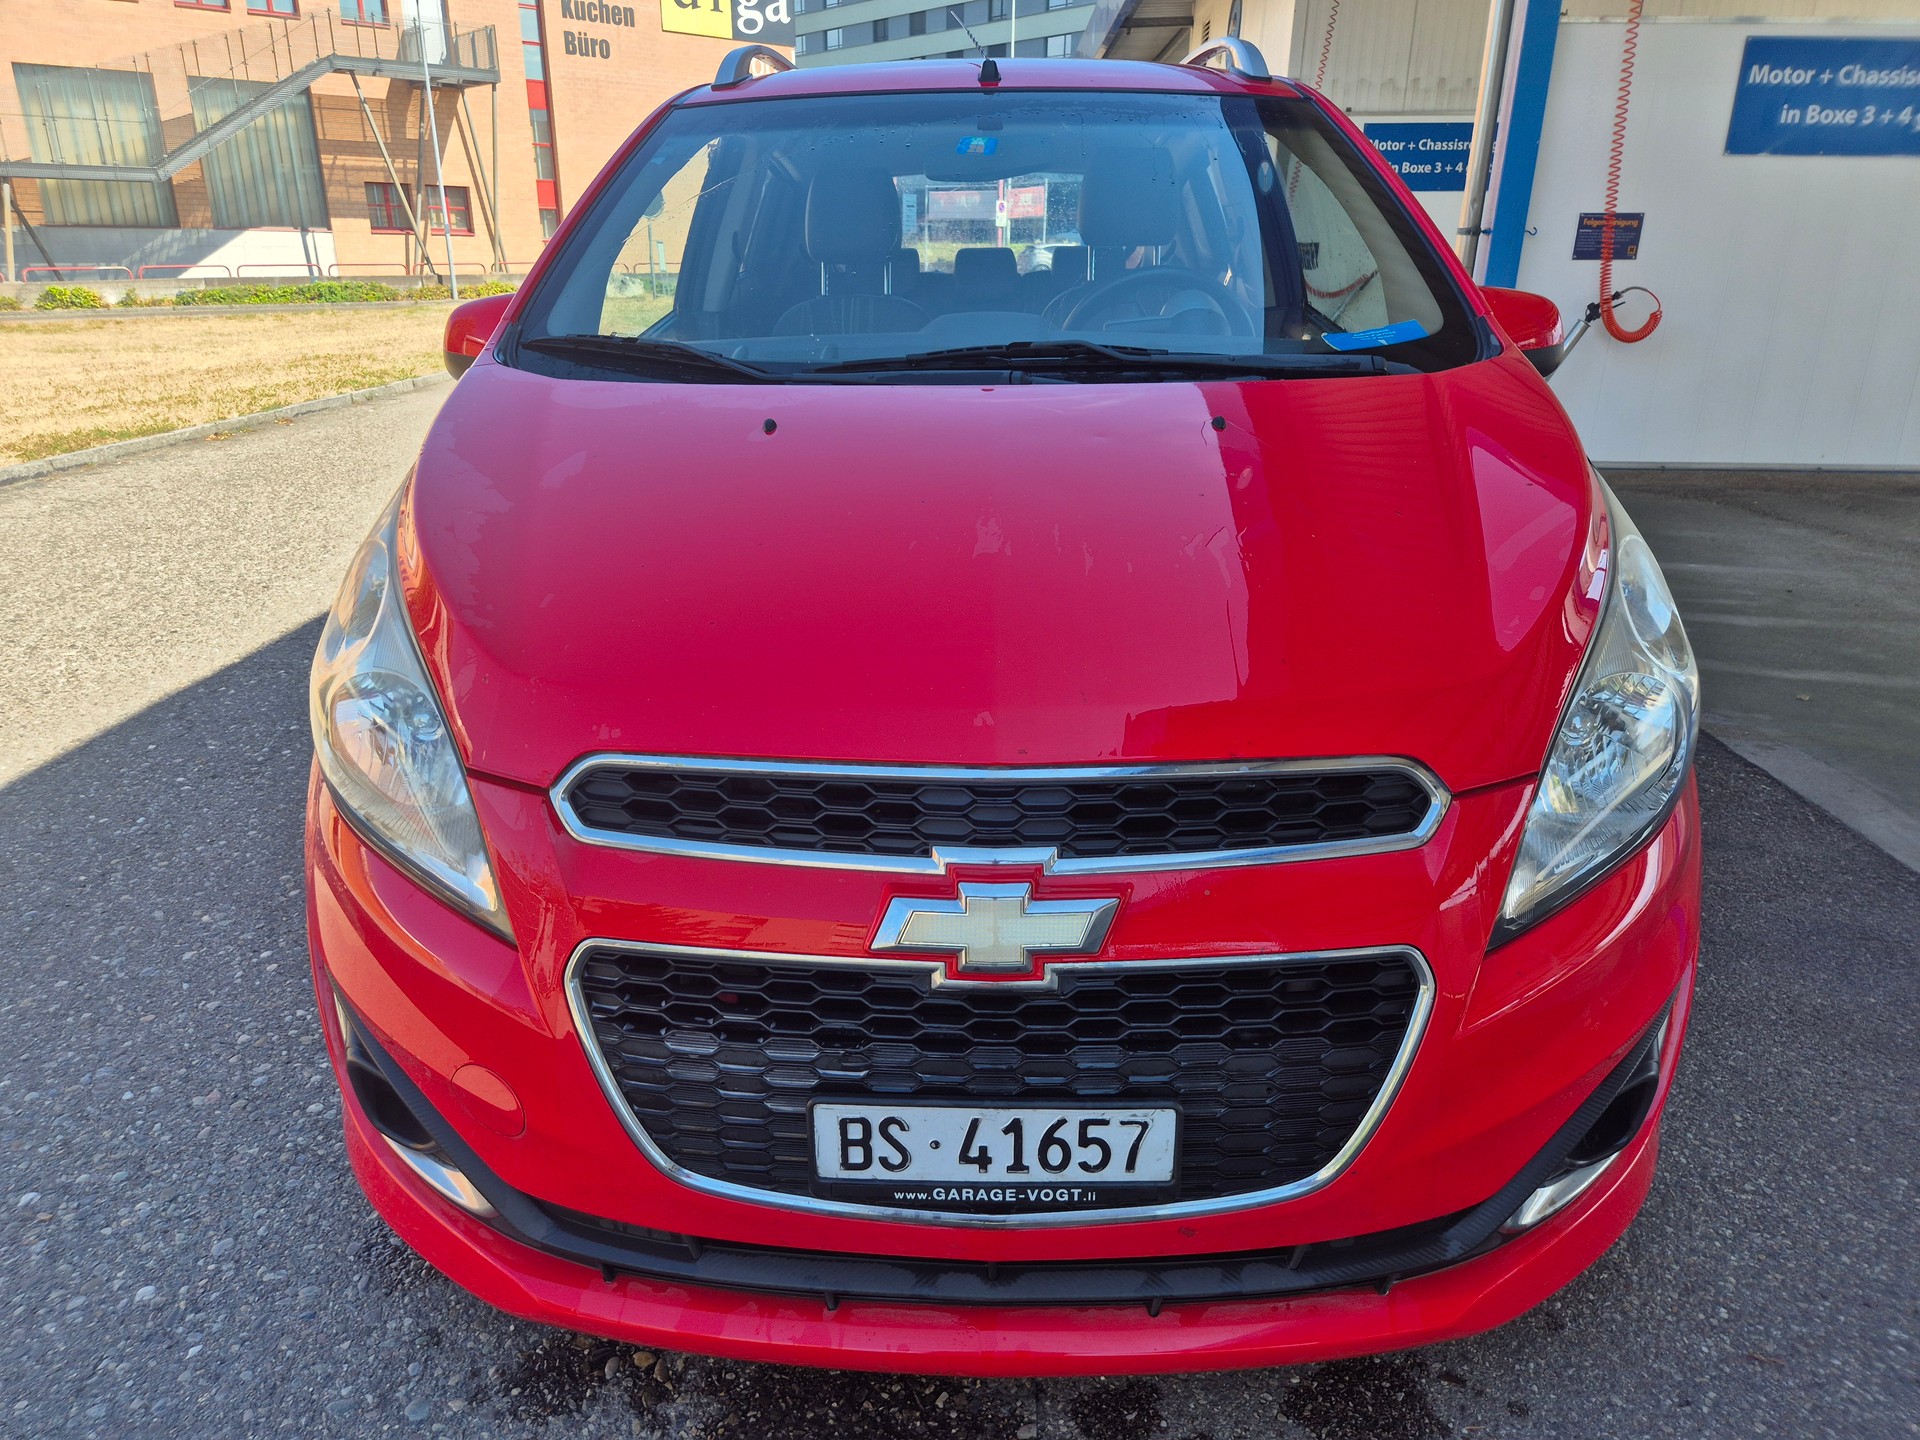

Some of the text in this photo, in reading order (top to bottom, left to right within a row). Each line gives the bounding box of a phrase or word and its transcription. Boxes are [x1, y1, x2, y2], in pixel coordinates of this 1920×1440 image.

[563, 30, 611, 59] Büro
[1749, 64, 1815, 84] Motor
[1820, 69, 1833, 84] +
[1780, 104, 1800, 124] in
[1806, 105, 1858, 125] Boxe
[1862, 105, 1876, 125] 3
[1880, 109, 1894, 125] +
[1898, 105, 1913, 125] 4
[1408, 141, 1416, 150] +
[1402, 161, 1431, 174] Boxe
[1434, 162, 1442, 173] 3
[1455, 162, 1464, 173] 4
[838, 1116, 911, 1173] BS
[958, 1115, 1154, 1174] 41657
[893, 1187, 1096, 1202] www.GARAGE-VOGT.li
